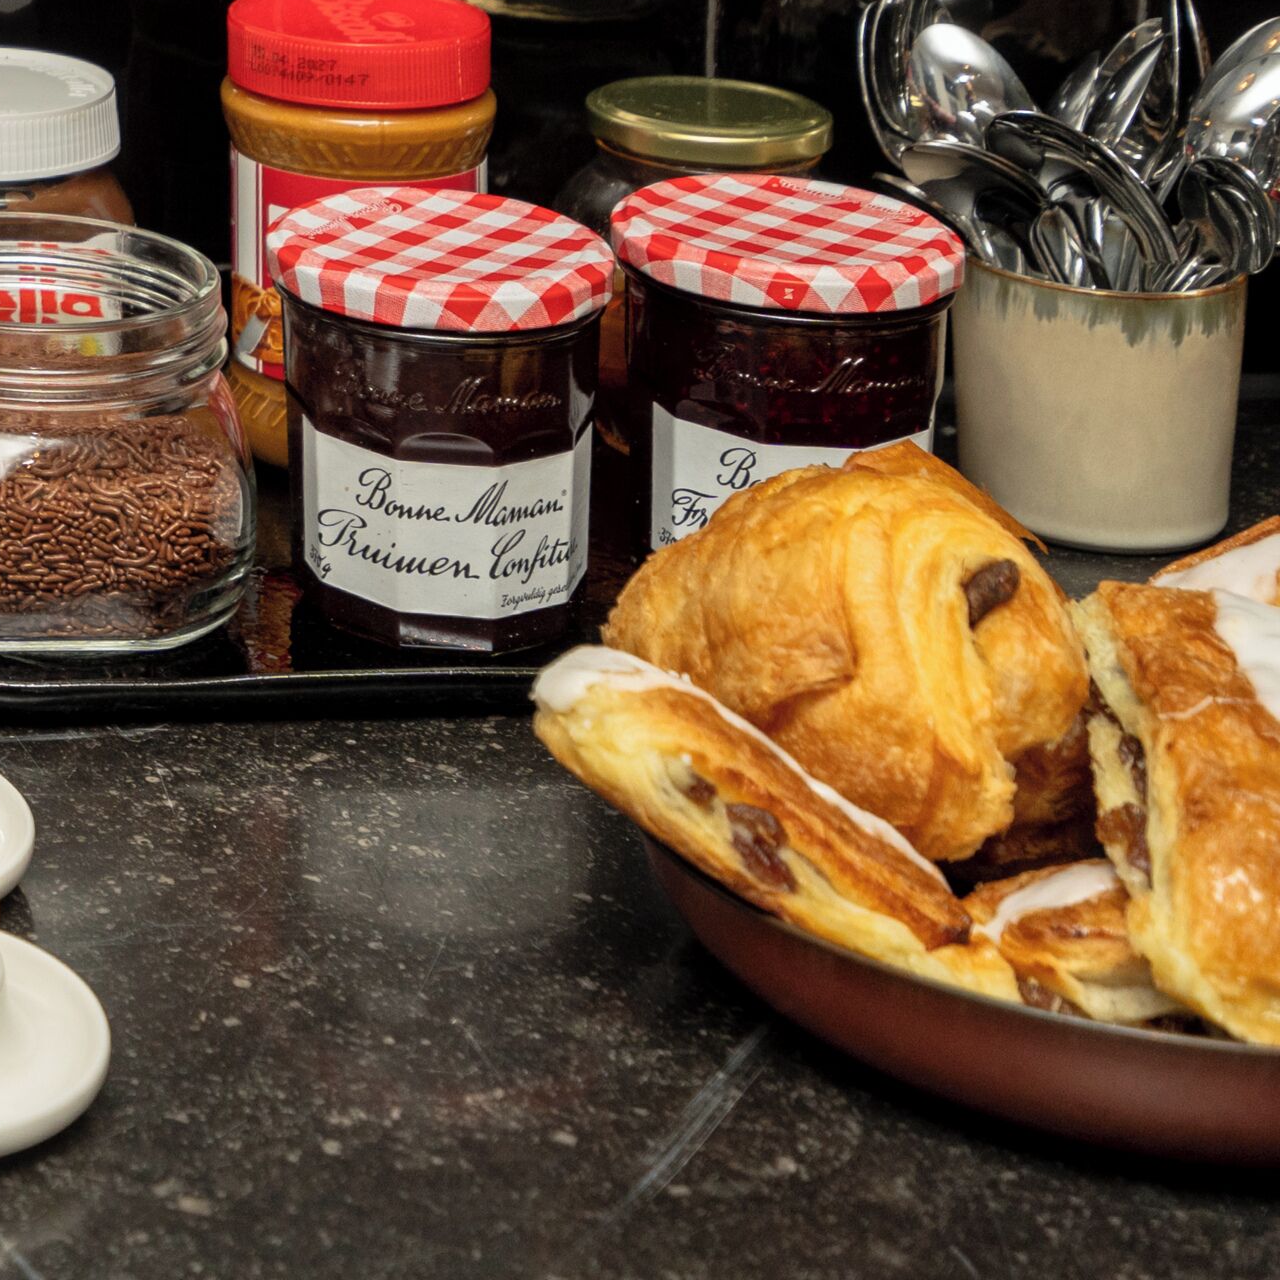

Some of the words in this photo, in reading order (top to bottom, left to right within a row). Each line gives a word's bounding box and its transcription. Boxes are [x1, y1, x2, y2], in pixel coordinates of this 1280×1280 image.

[355, 467, 451, 522] Bonne
[454, 479, 565, 527] Maman
[317, 508, 480, 580] Pruimen
